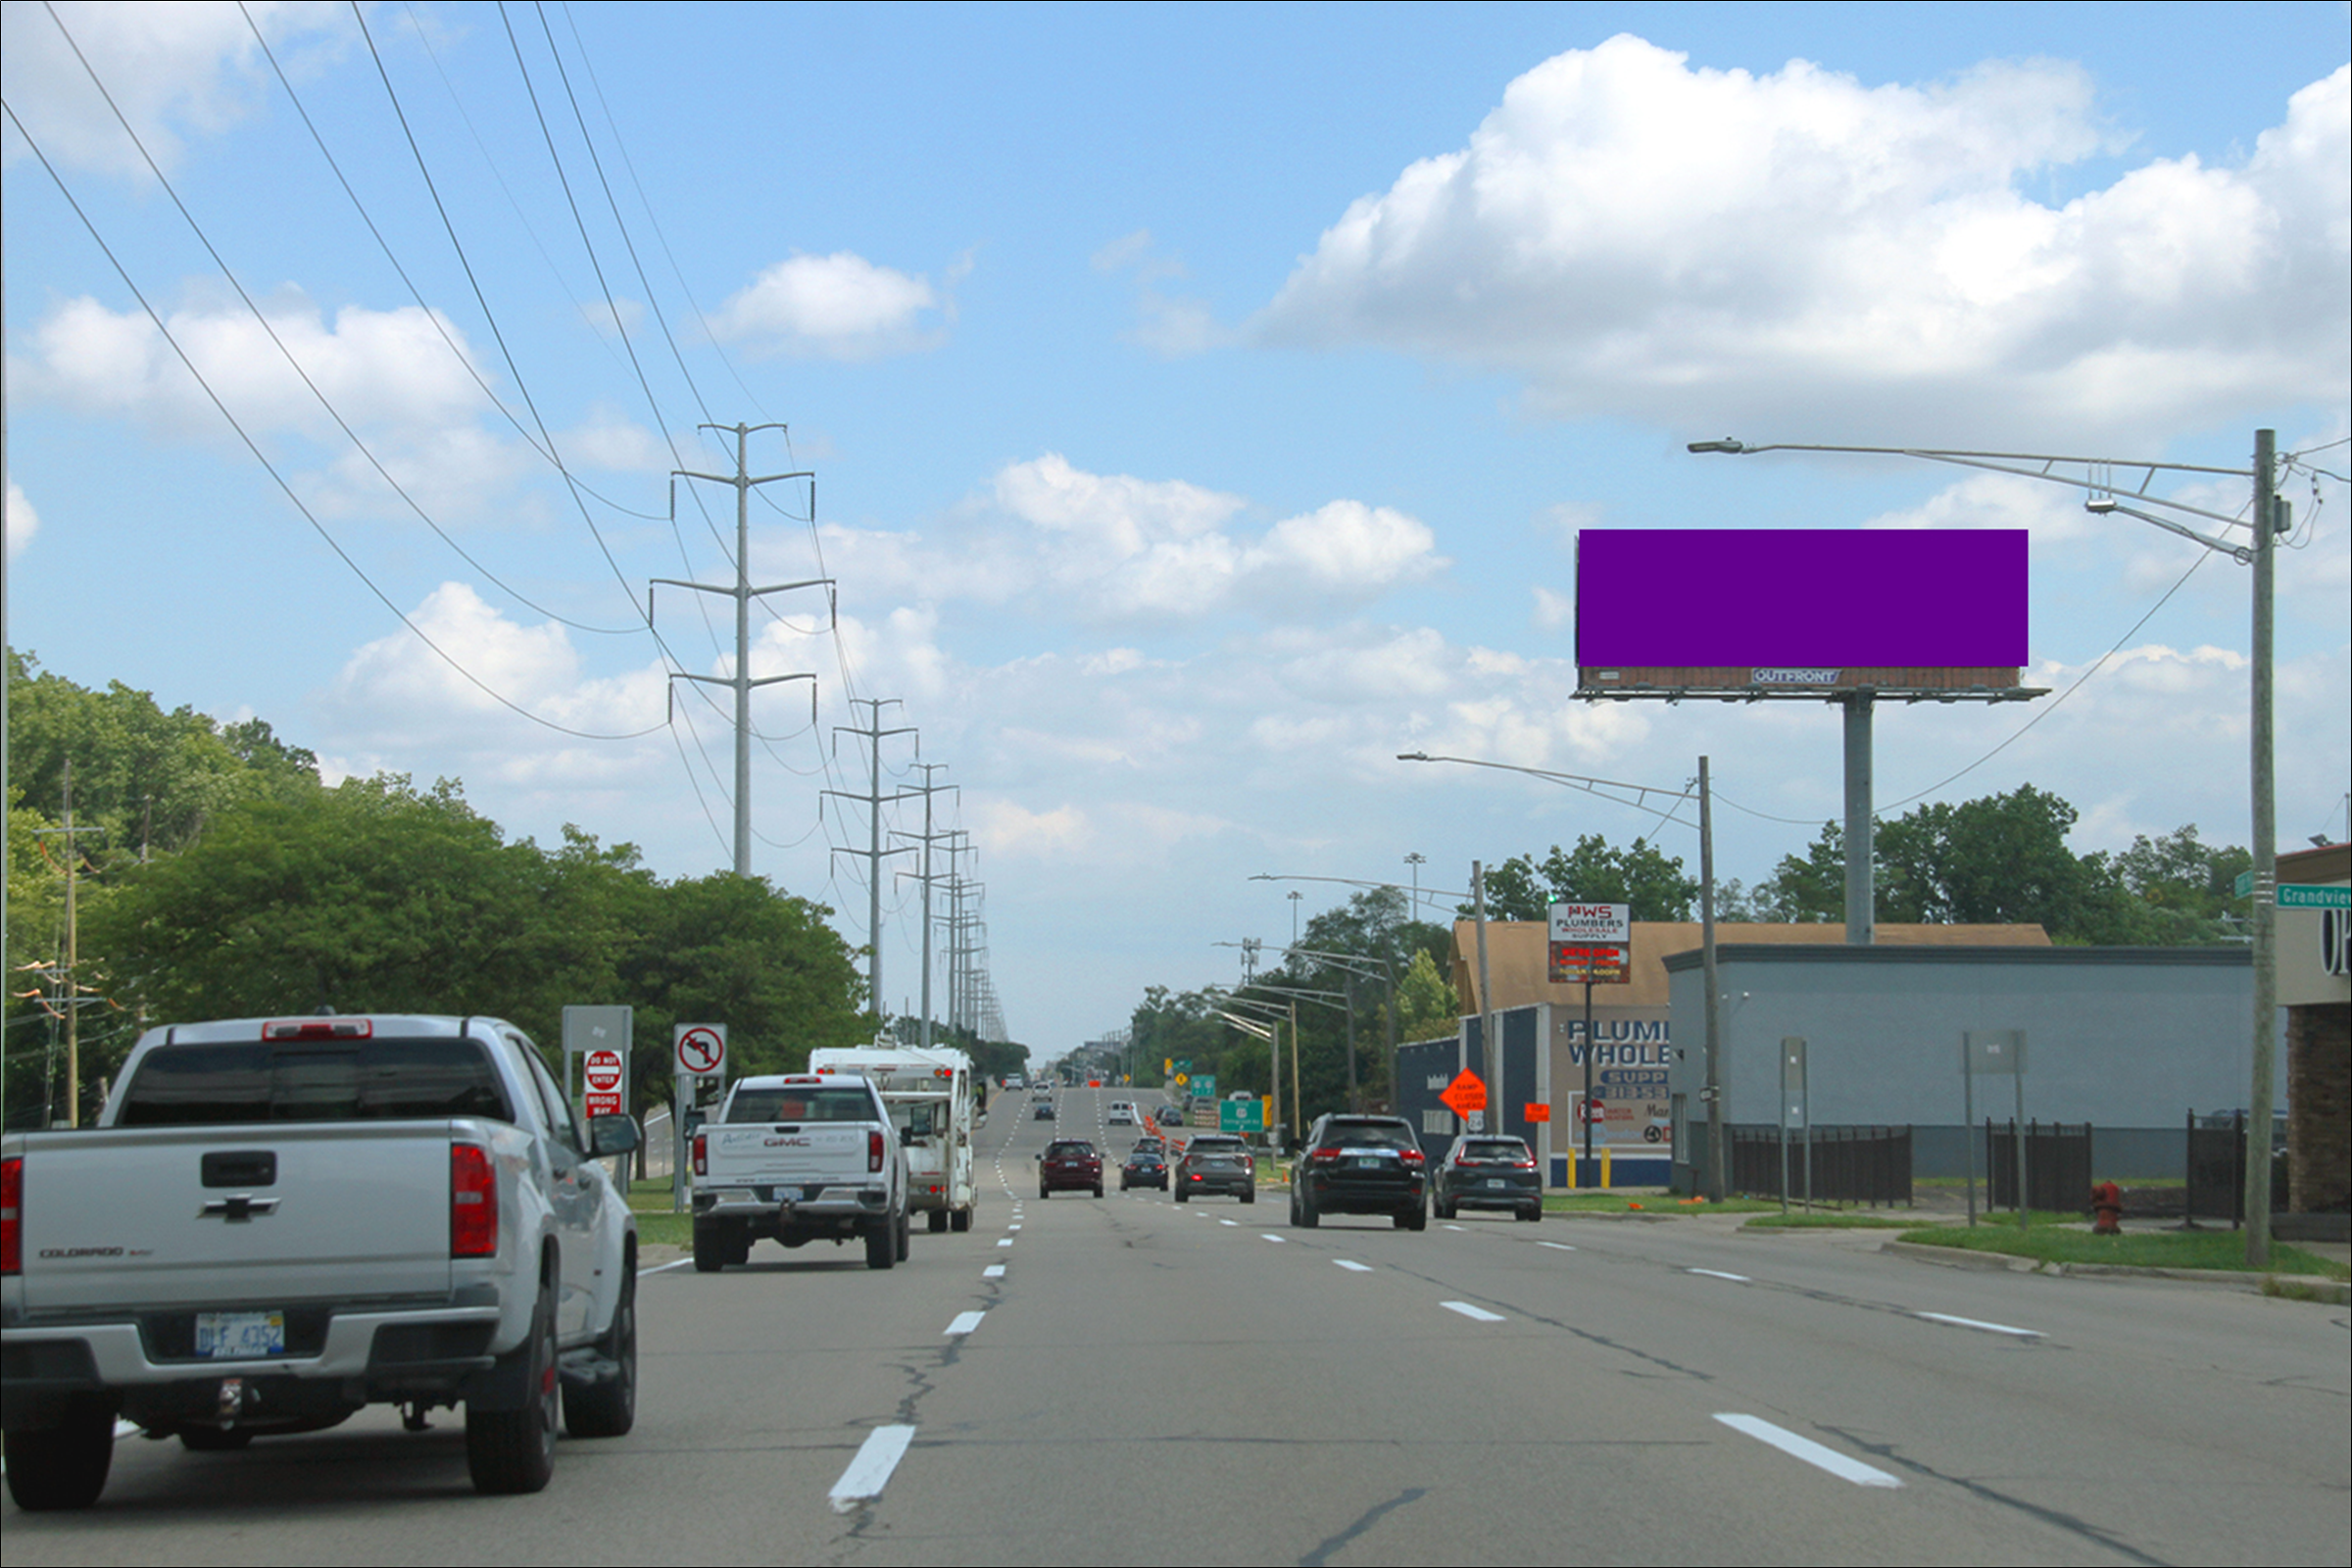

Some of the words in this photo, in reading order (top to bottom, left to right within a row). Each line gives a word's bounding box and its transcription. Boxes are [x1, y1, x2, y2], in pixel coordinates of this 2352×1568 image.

[1754, 669, 1836, 683] OUTFRONT
[1556, 919, 1624, 928] PLUMBERS
[1568, 1020, 1669, 1043] PLUM
[589, 1096, 617, 1105] WRONG
[763, 1137, 811, 1148] GMC
[39, 1246, 123, 1258] COLORADO
